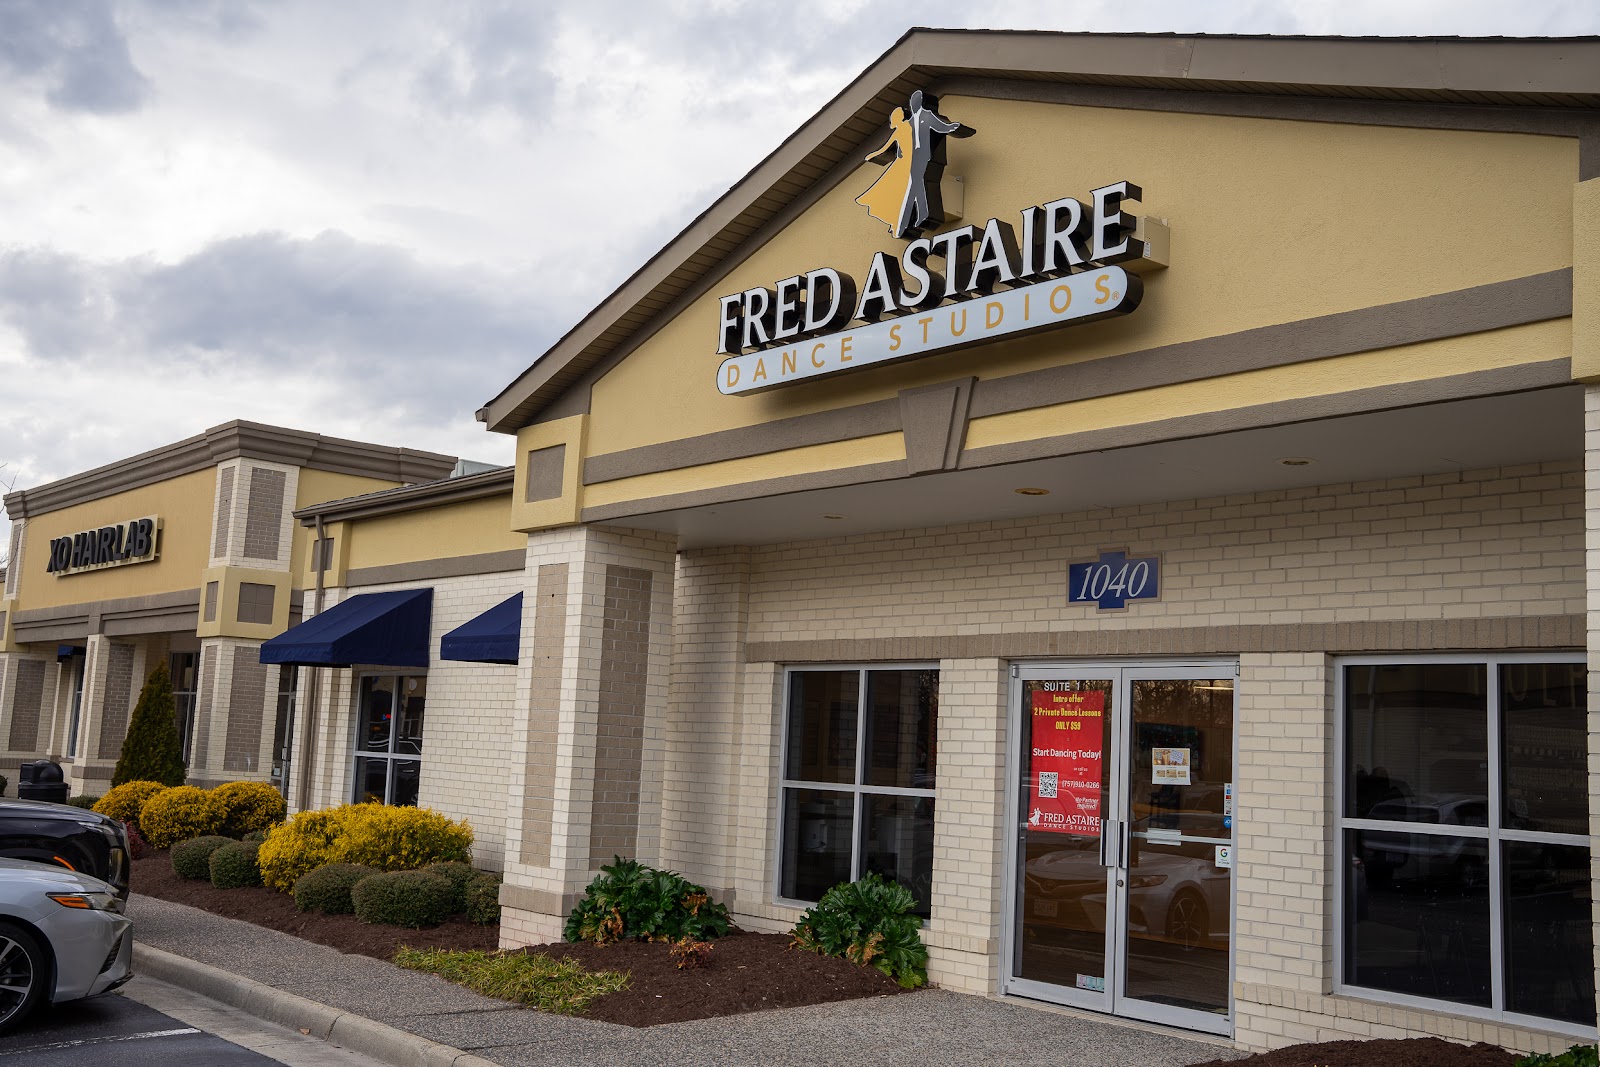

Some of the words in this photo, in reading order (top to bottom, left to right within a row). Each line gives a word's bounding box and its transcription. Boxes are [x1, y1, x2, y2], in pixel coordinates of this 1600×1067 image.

[715, 266, 850, 355] FRED
[854, 180, 1134, 320] ASTAIRE
[725, 335, 853, 388] DANCE
[46, 536, 72, 573] XO
[1076, 561, 1149, 600] 1040
[1043, 681, 1071, 692] SUITE
[1053, 694, 1068, 703] Intro
[1068, 693, 1084, 703] offer
[1034, 707, 1038, 716] 2
[1039, 707, 1060, 716] Private
[1061, 708, 1078, 717] Dance
[1078, 708, 1101, 717] Lessons
[1055, 721, 1070, 730] ONLY
[1033, 747, 1049, 757] Start
[1050, 748, 1077, 760] Dancing
[1078, 749, 1101, 760] Today!
[1043, 812, 1064, 823] FRED
[1066, 815, 1100, 826] ASTAIRE
